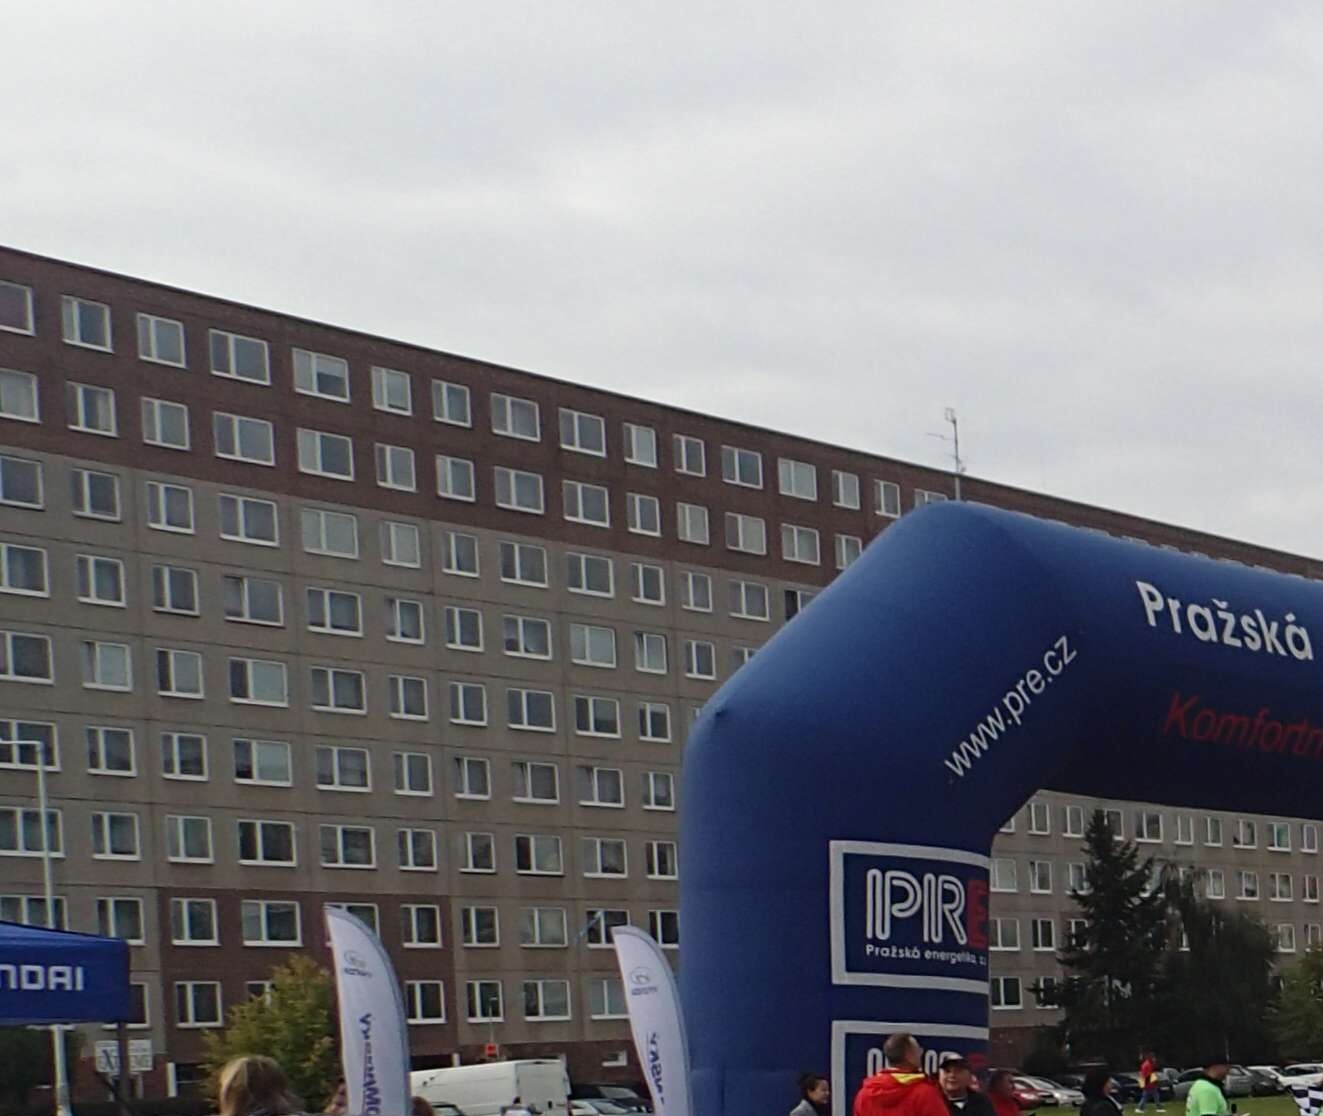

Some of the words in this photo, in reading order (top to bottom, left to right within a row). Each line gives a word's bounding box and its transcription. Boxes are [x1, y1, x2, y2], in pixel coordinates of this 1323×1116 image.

[1136, 580, 1313, 661] Pražská
[943, 635, 1077, 777] www.pre.cz
[866, 868, 988, 950] PRE
[865, 943, 921, 959] Pražská
